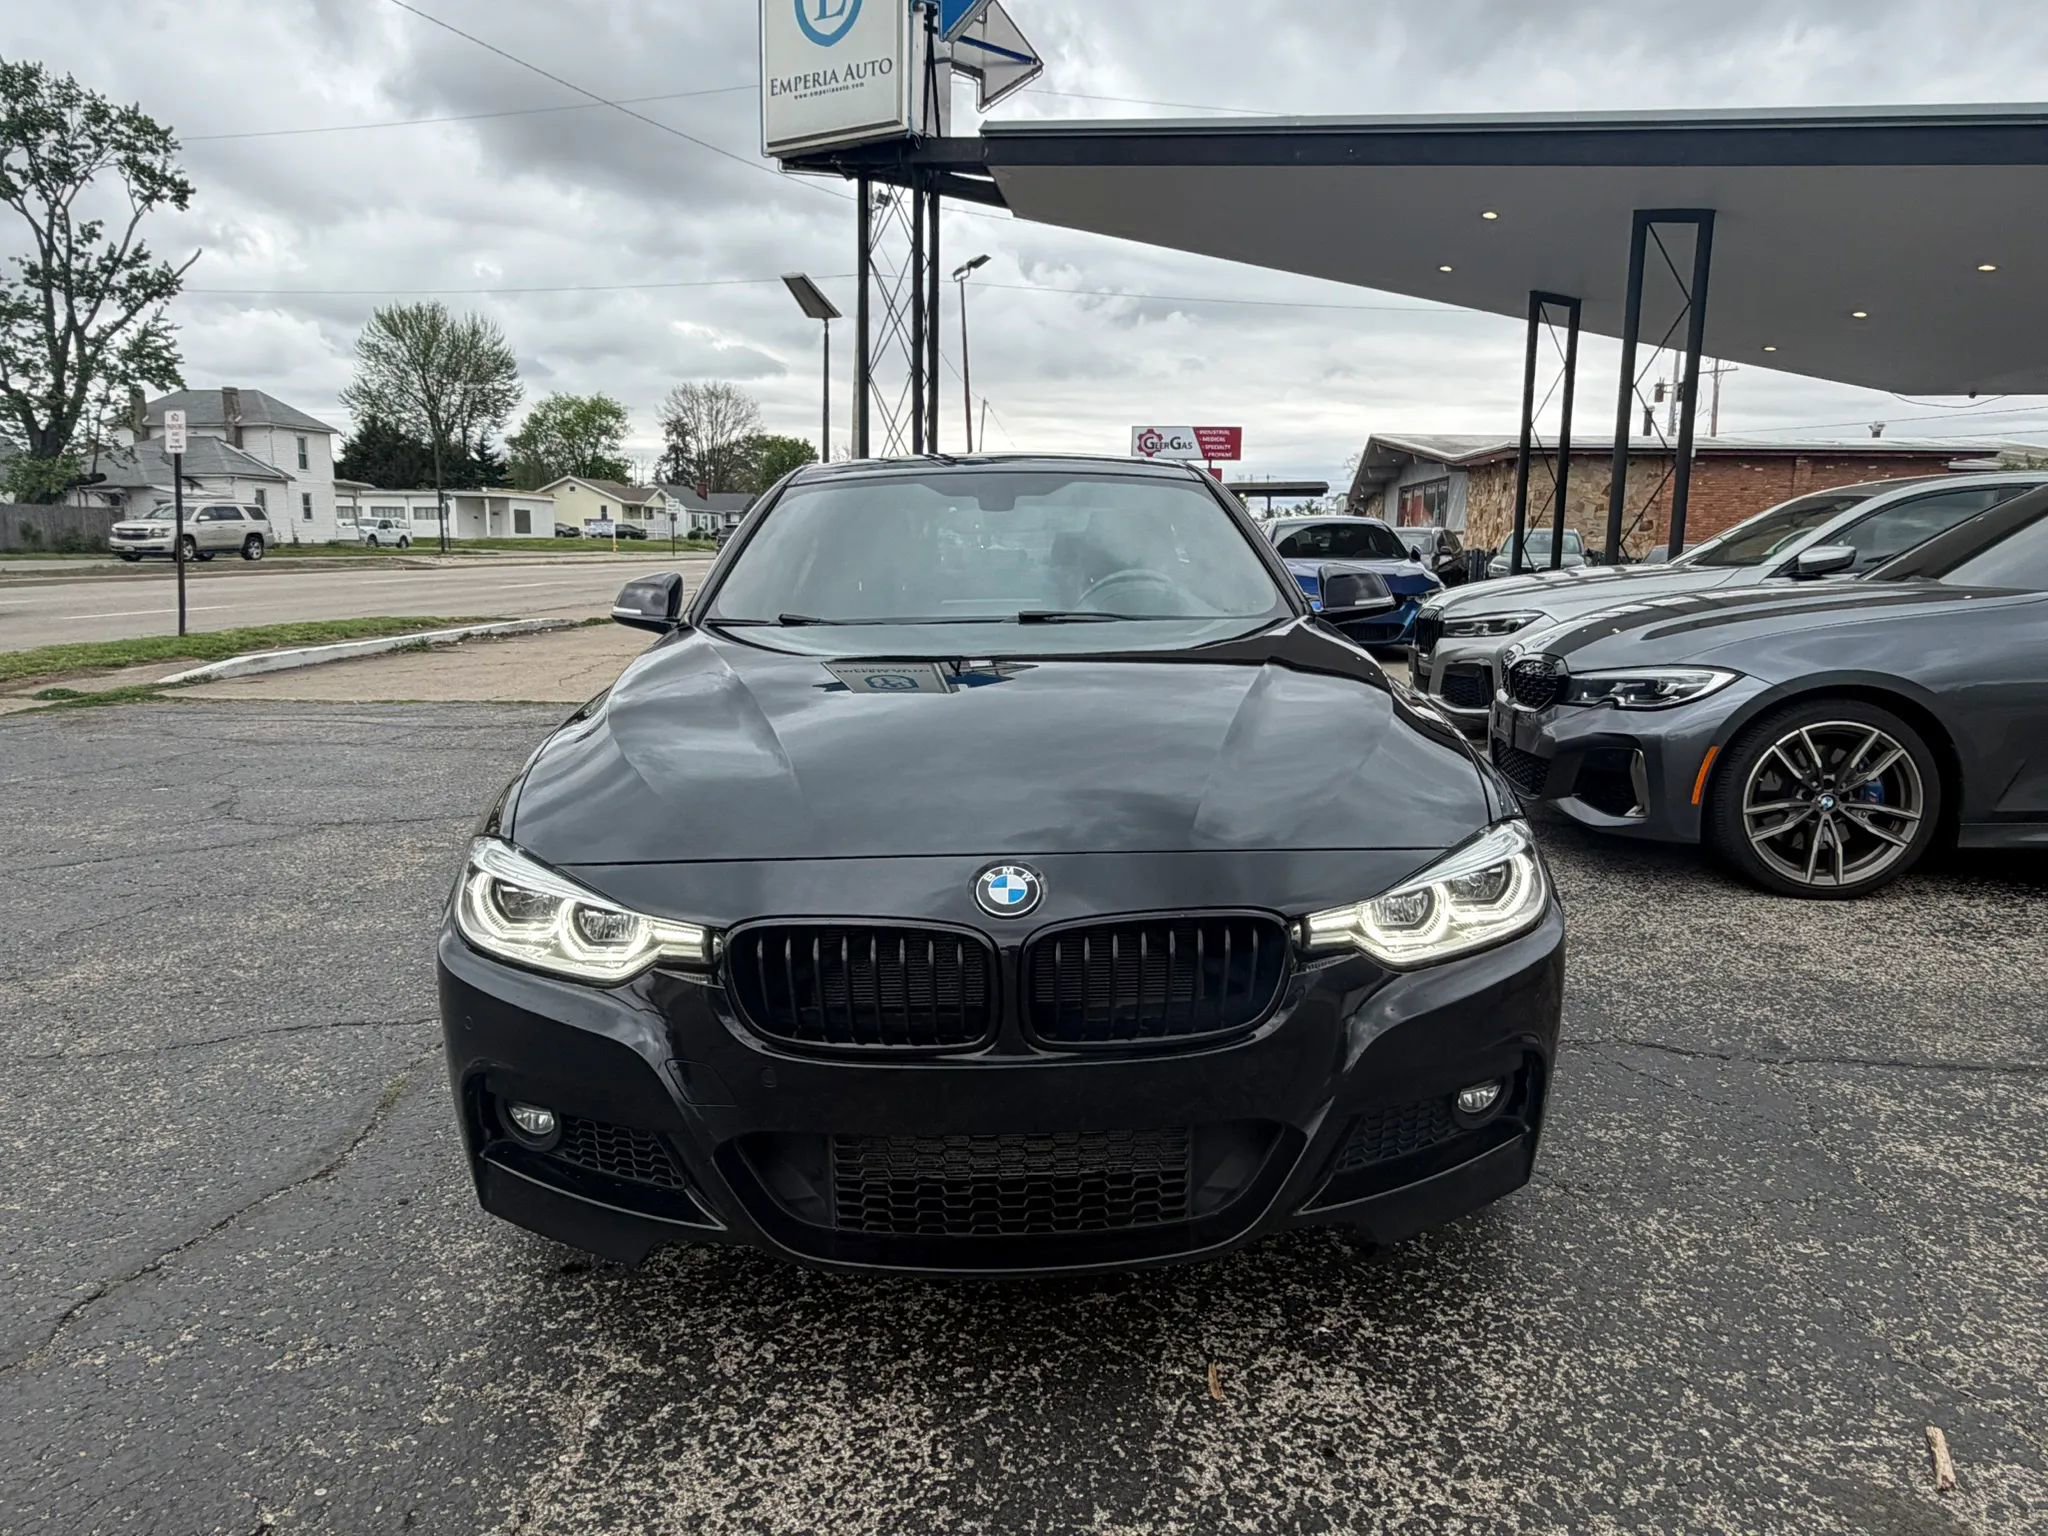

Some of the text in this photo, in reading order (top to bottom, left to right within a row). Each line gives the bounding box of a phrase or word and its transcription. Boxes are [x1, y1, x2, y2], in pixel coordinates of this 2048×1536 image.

[770, 57, 893, 96] EMPERIA AUTO
[983, 866, 1034, 882] BMW
